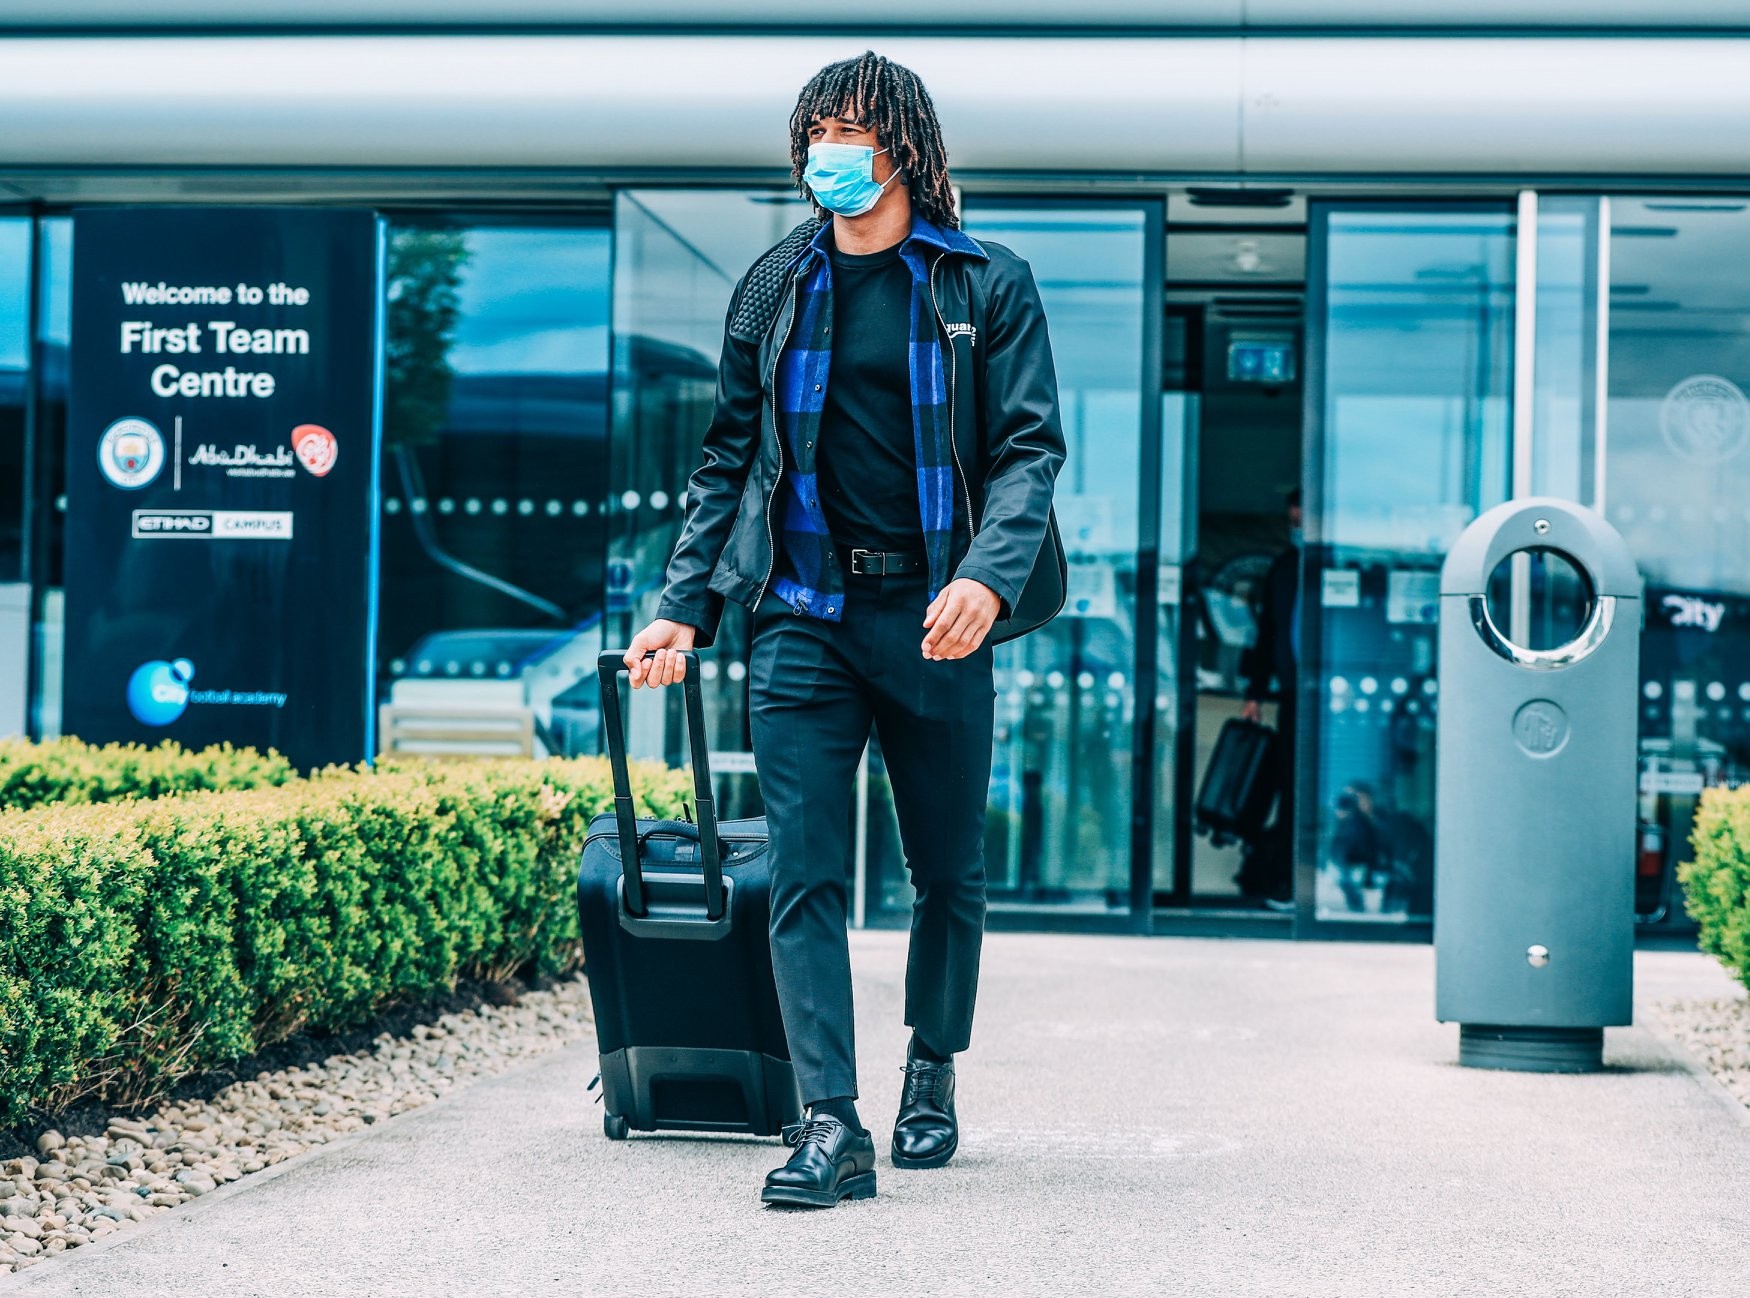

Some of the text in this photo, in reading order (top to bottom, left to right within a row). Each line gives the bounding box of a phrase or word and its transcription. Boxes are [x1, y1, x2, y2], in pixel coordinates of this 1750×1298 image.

[121, 282, 310, 305] Welcome to the
[120, 321, 309, 354] First Team
[151, 364, 275, 397] Centre
[138, 516, 283, 531] ETIHAD CAMPUS
